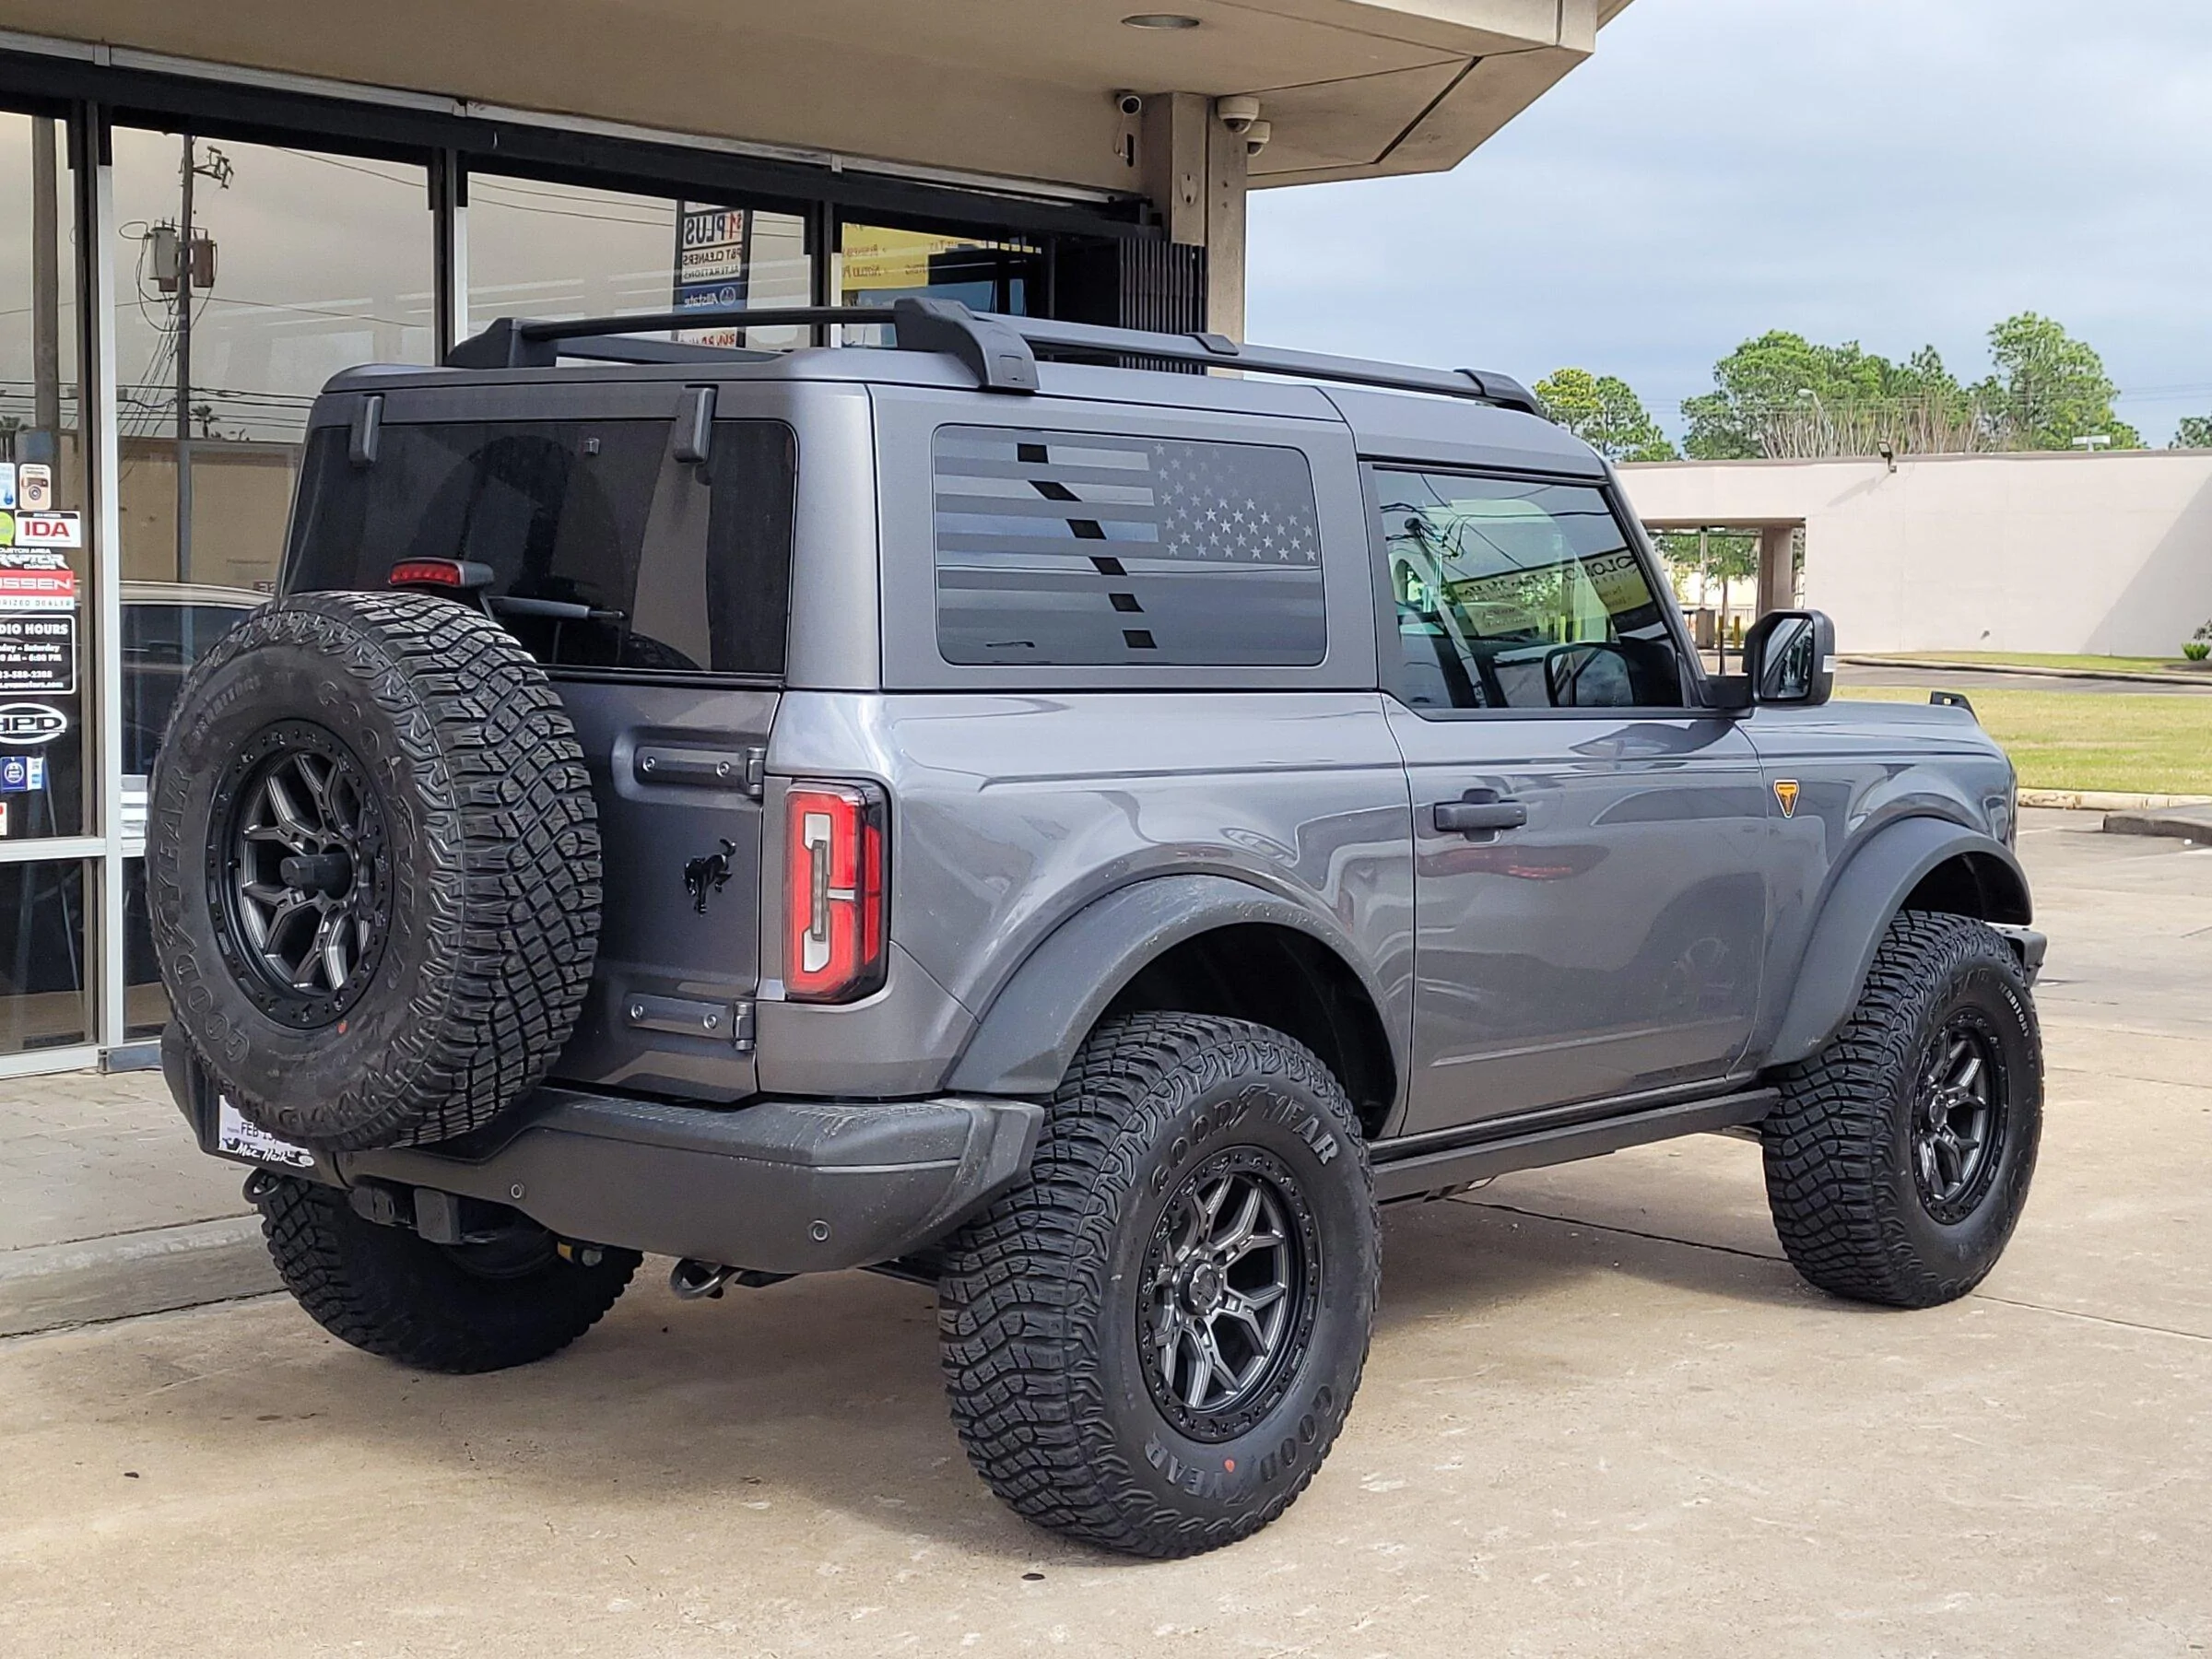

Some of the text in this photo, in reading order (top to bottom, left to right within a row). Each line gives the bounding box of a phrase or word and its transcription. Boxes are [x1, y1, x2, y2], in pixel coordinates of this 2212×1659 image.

[24, 521, 71, 537] IDA
[0, 578, 71, 591] SSEN
[24, 623, 69, 635] HOURS
[241, 1121, 259, 1138] FEB
[1150, 1082, 1339, 1200] GOODYEAR
